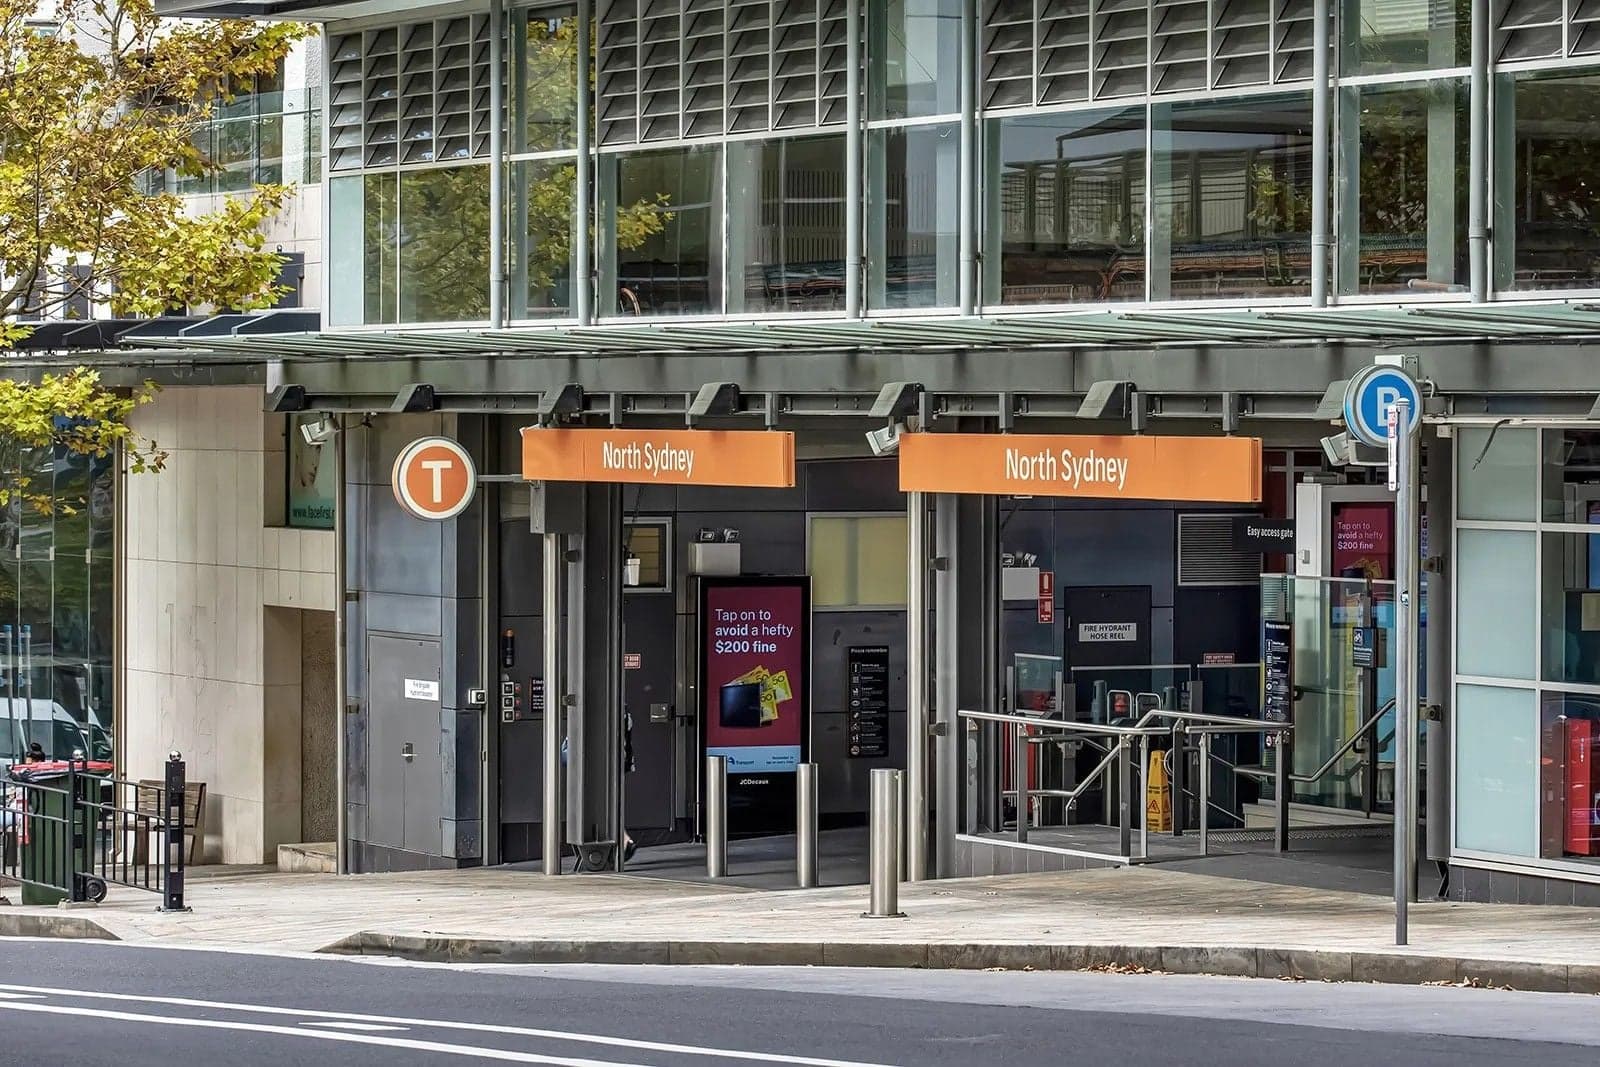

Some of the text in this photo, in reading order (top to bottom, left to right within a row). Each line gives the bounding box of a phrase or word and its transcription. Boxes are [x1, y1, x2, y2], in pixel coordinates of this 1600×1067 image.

[603, 441, 694, 479] North Sydney
[1006, 447, 1129, 492] North Sydney
[421, 459, 452, 503] T
[1338, 521, 1351, 530] Tap
[1362, 522, 1370, 530] to
[1248, 526, 1293, 540] Easy access gate
[1338, 531, 1357, 539] avoid
[1364, 531, 1383, 541] hefty
[1338, 540, 1374, 550] $200 fine
[715, 608, 771, 623] Tap on to
[715, 623, 793, 638] avoid a hefty
[1084, 624, 1131, 632] FIRE HYDRANT
[1090, 632, 1126, 640] HOSE REEL
[715, 639, 777, 654] $200 fine
[772, 675, 785, 685] 50
